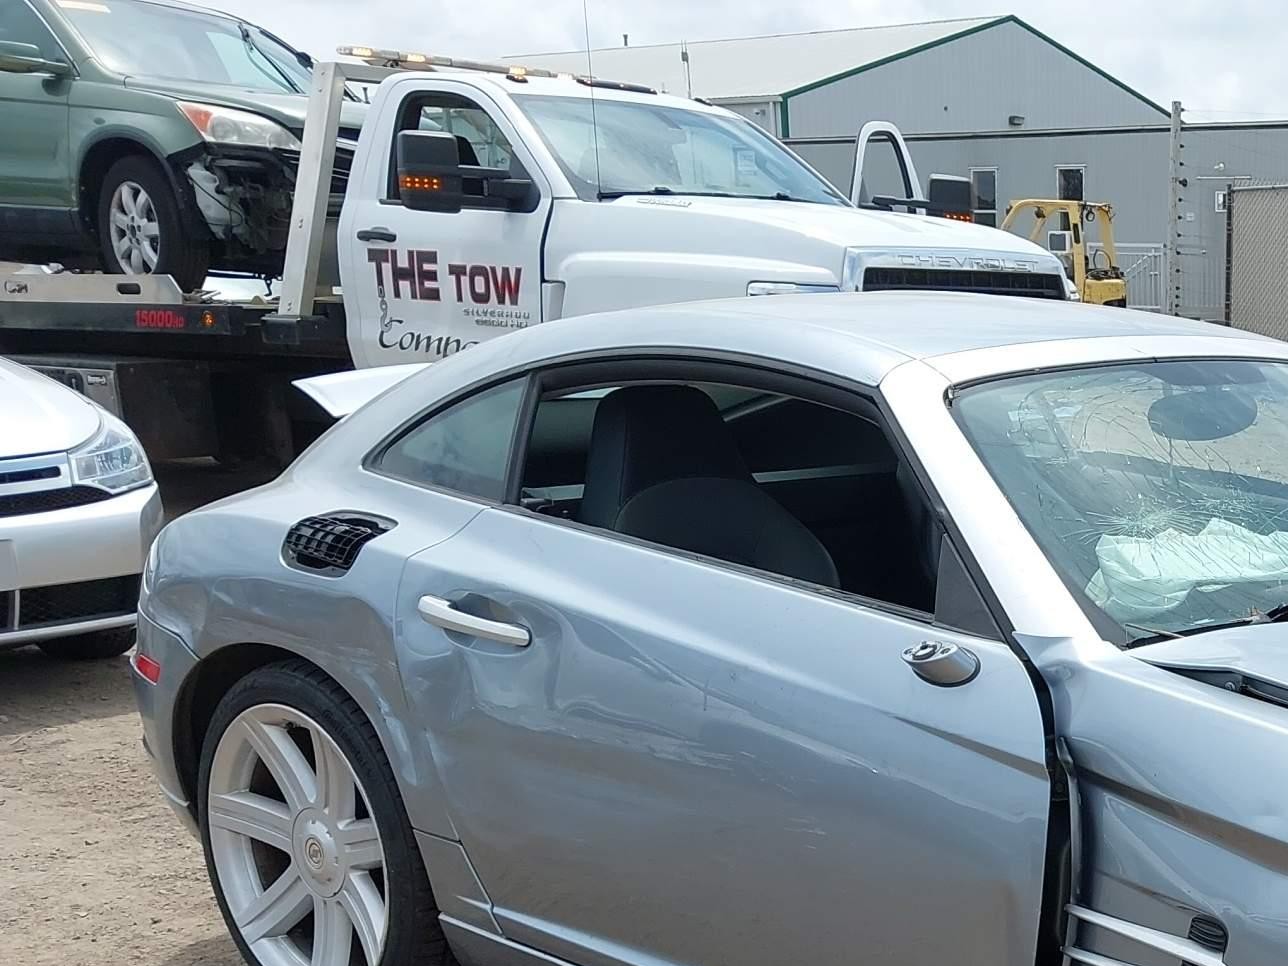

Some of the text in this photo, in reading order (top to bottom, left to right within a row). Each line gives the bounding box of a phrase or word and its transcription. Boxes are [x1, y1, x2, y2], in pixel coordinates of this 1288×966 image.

[367, 247, 522, 307] THE TOW
[898, 255, 1039, 272] CHEVROLET
